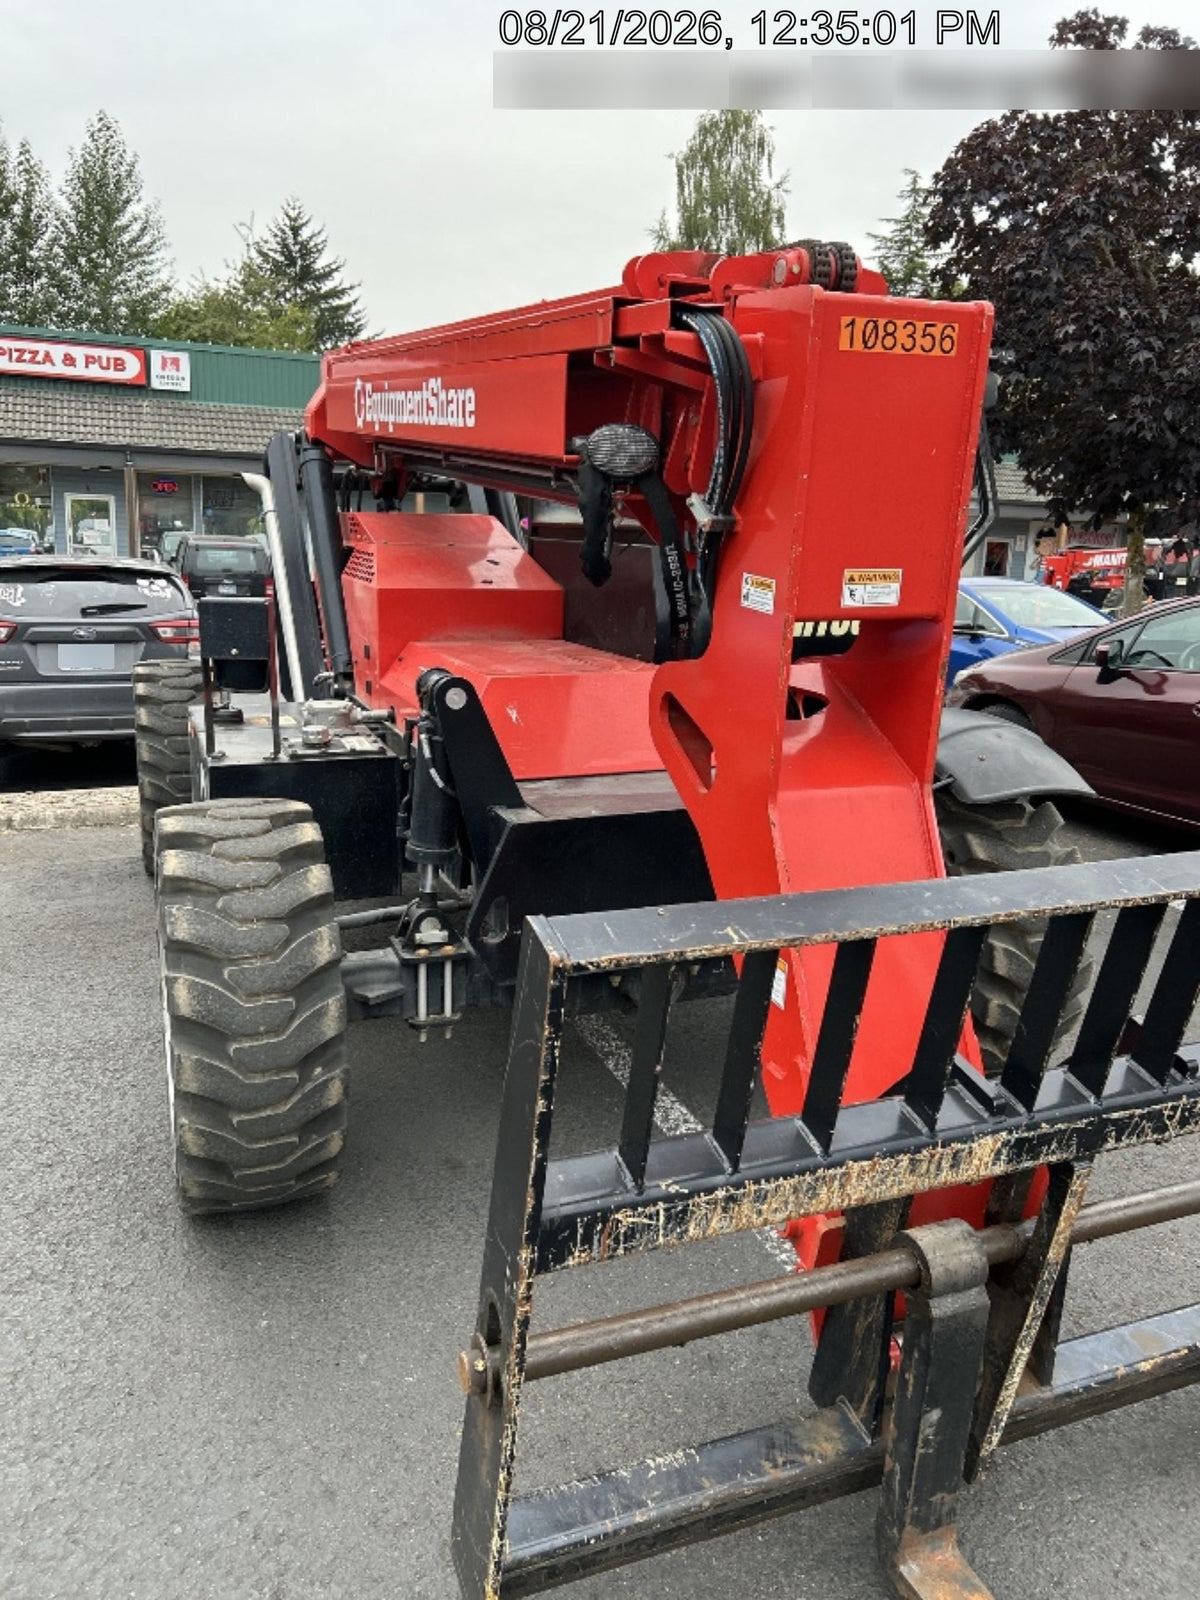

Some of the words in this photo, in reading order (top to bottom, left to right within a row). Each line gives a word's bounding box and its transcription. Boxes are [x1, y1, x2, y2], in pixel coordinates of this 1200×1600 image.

[844, 318, 956, 354] 108356
[0, 346, 55, 366] PIZZA
[62, 352, 77, 368] &
[84, 354, 127, 372] PUB
[365, 377, 476, 432] EquipmentShare
[1093, 552, 1128, 567] MANIT
